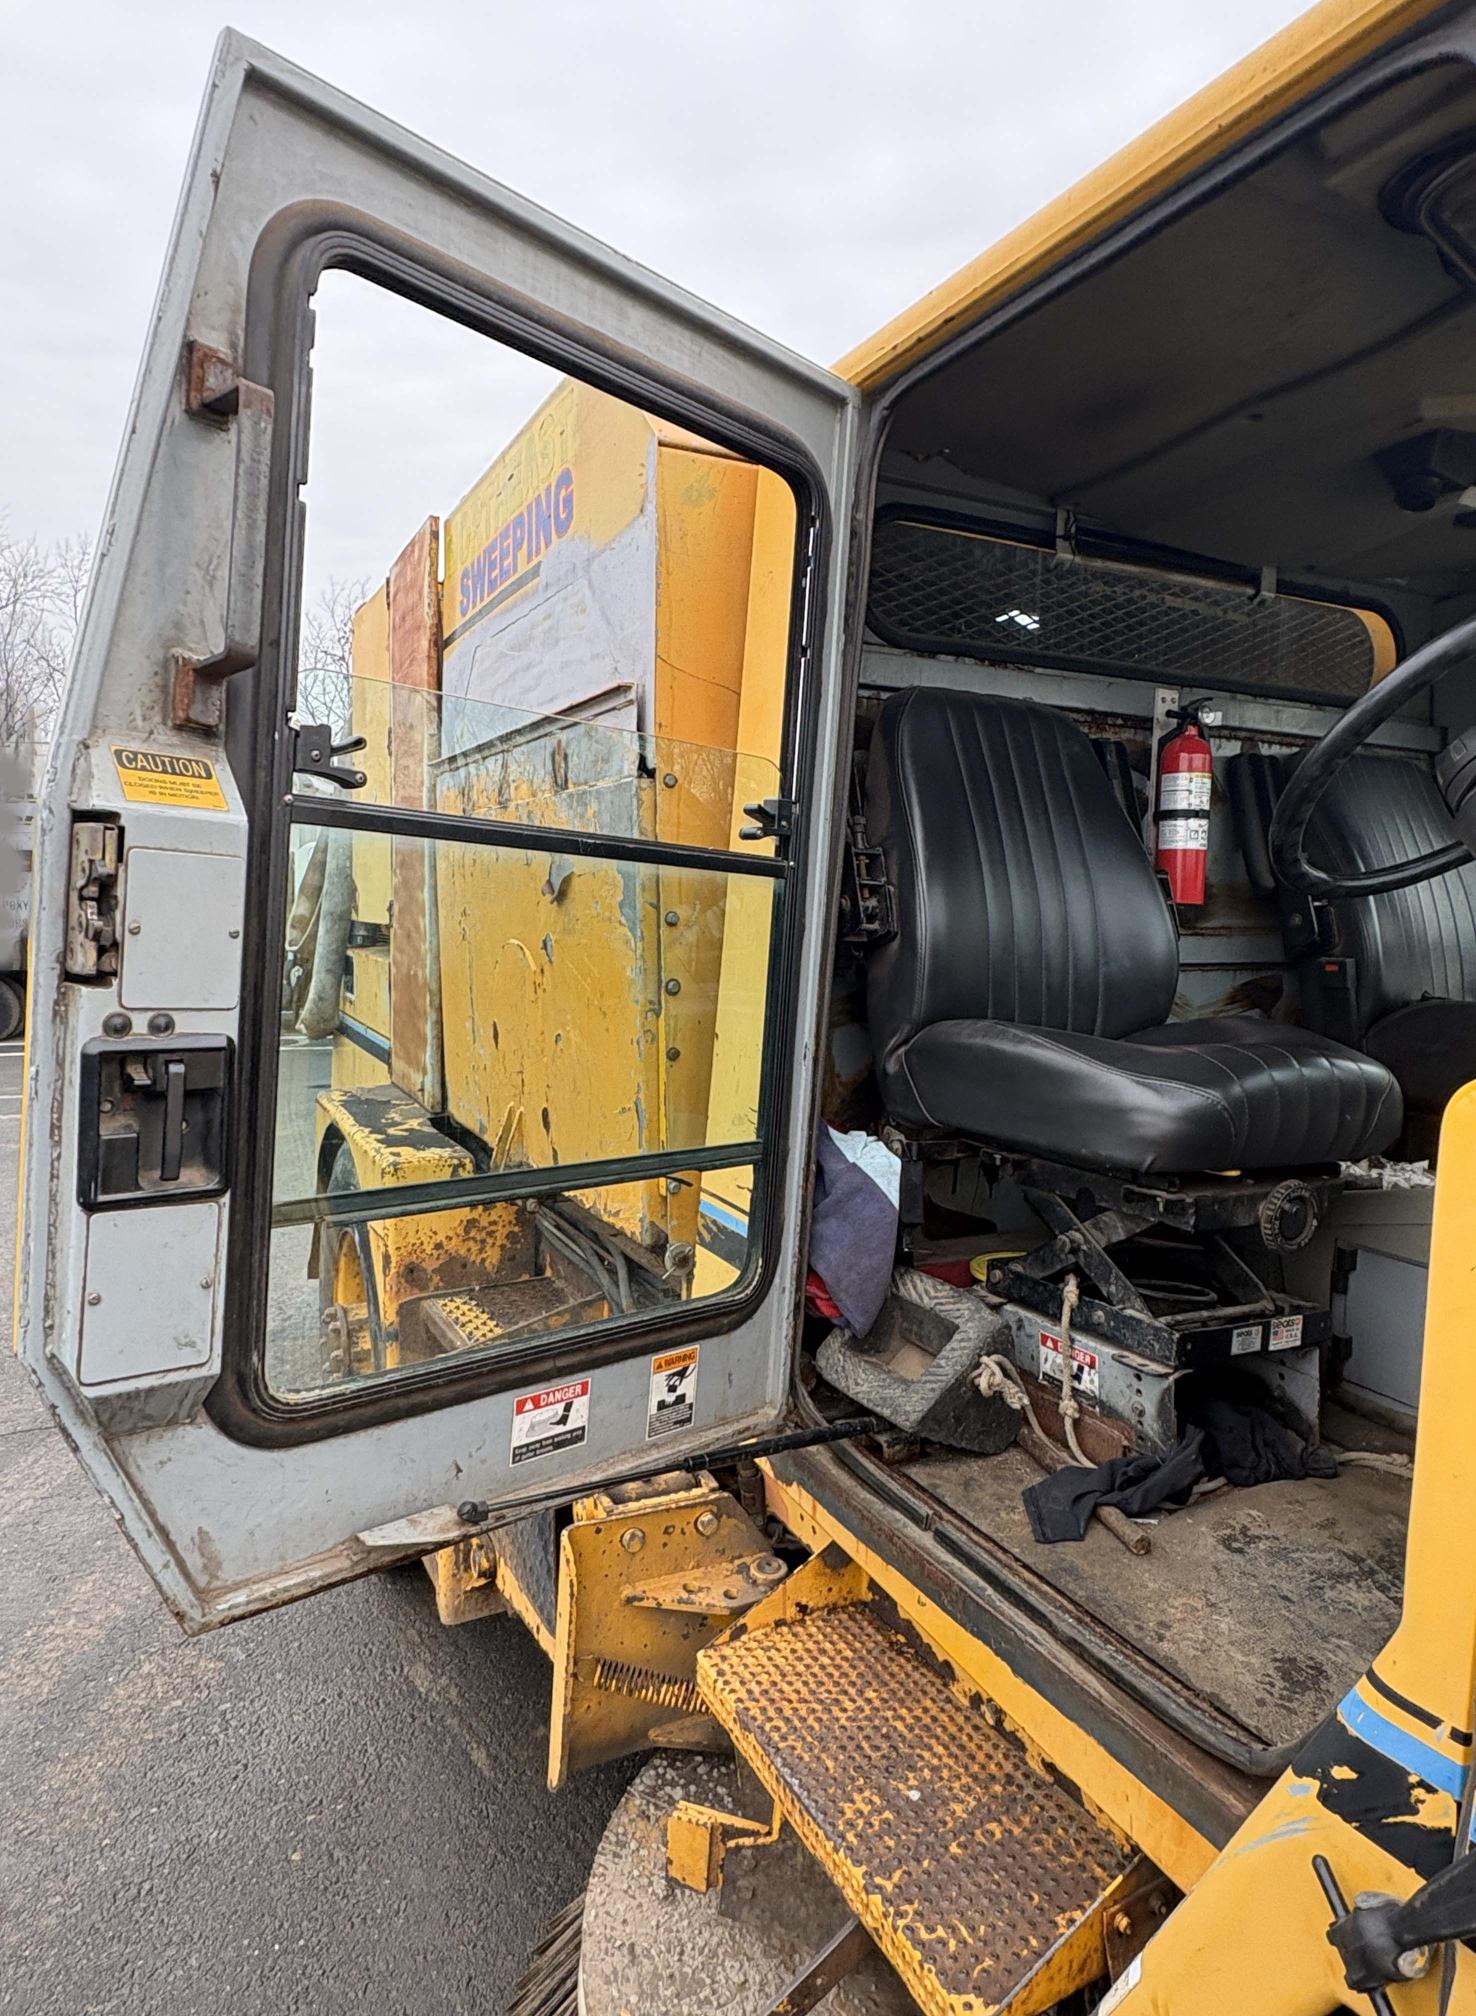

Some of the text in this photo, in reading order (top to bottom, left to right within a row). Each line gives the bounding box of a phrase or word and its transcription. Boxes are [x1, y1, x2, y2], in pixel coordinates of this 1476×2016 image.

[460, 467, 574, 618] SWEEPING
[121, 751, 207, 777] CAUTION
[124, 780, 158, 790] CLOSED
[159, 784, 182, 793] WHEN
[664, 1351, 696, 1367] WARNING
[540, 1384, 583, 1407] DANGER
